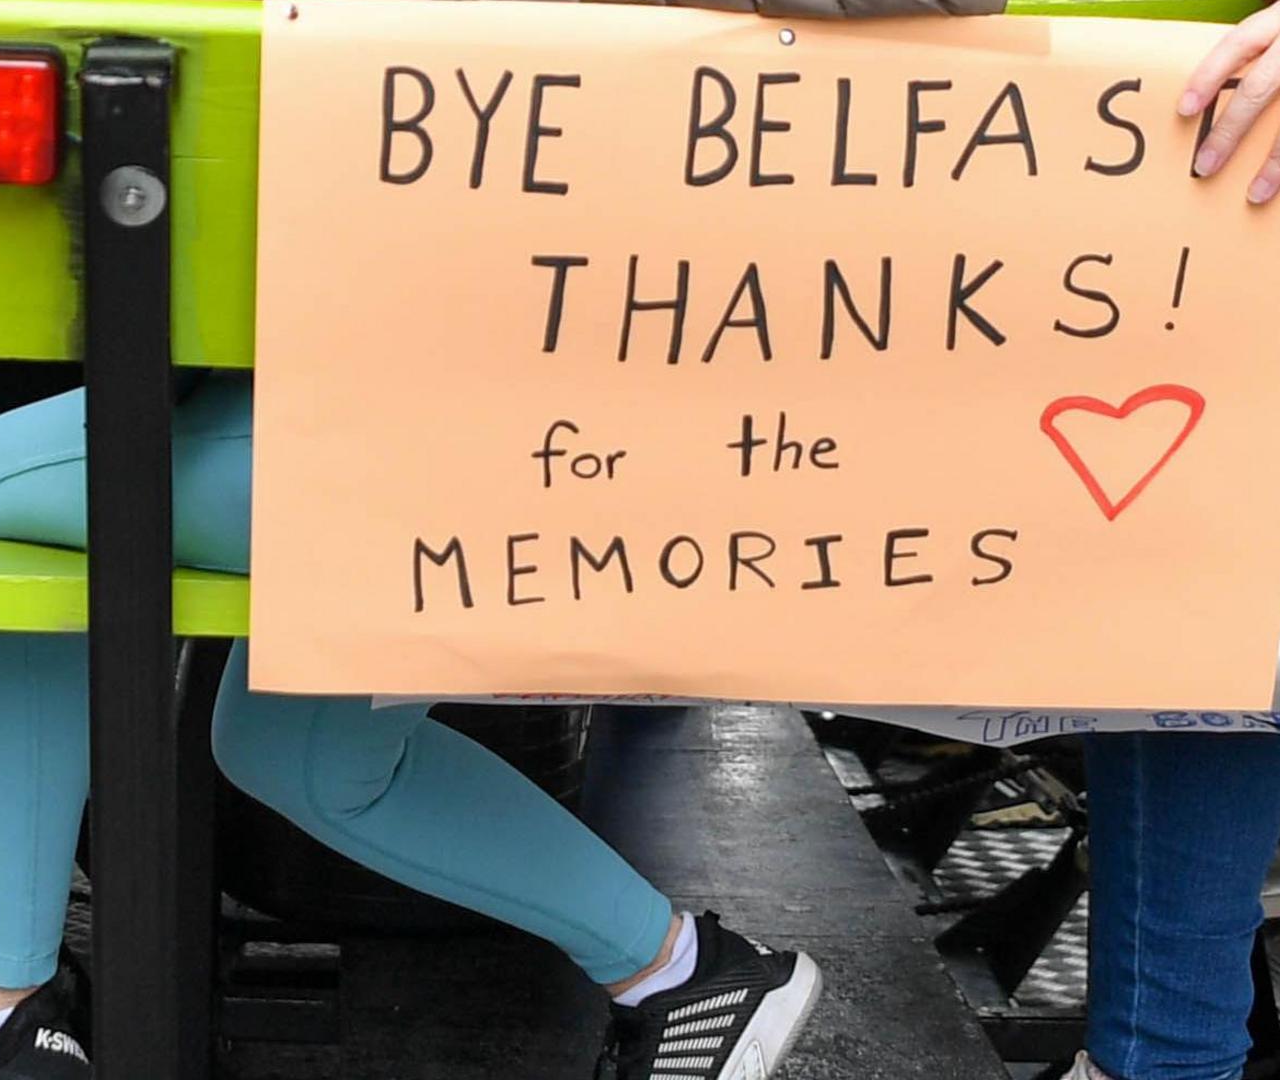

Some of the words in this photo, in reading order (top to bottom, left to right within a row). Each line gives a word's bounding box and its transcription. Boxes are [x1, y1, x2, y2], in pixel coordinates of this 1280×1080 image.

[380, 68, 581, 195] BYE
[531, 247, 1191, 364] THANKS!
[531, 419, 627, 488] for
[726, 411, 840, 477] the
[414, 528, 1018, 612] MEMORIES
